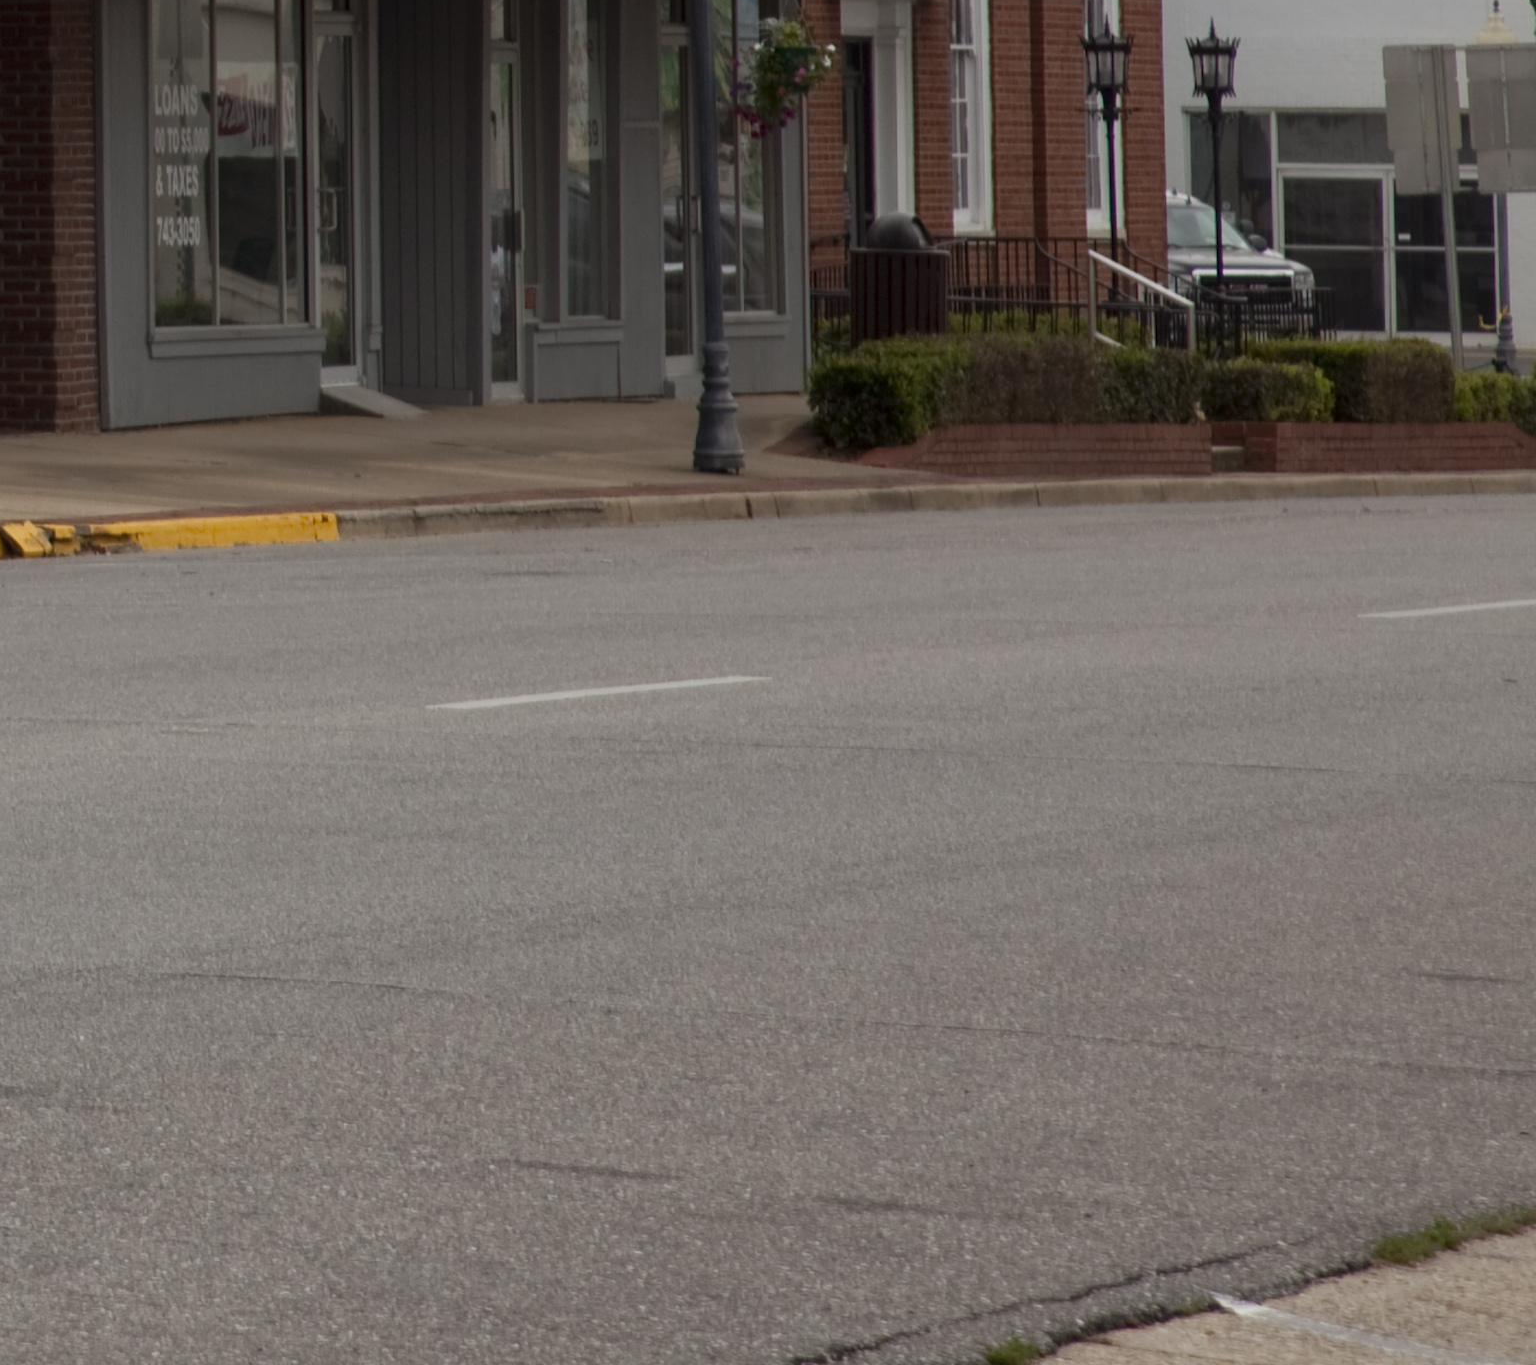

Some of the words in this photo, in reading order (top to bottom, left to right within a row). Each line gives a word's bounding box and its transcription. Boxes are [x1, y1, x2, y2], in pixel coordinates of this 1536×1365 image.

[154, 84, 199, 116] LOANS
[167, 127, 180, 153] TO
[155, 164, 164, 198] &
[166, 164, 200, 198] TAXES
[156, 216, 201, 247] 743-3050
